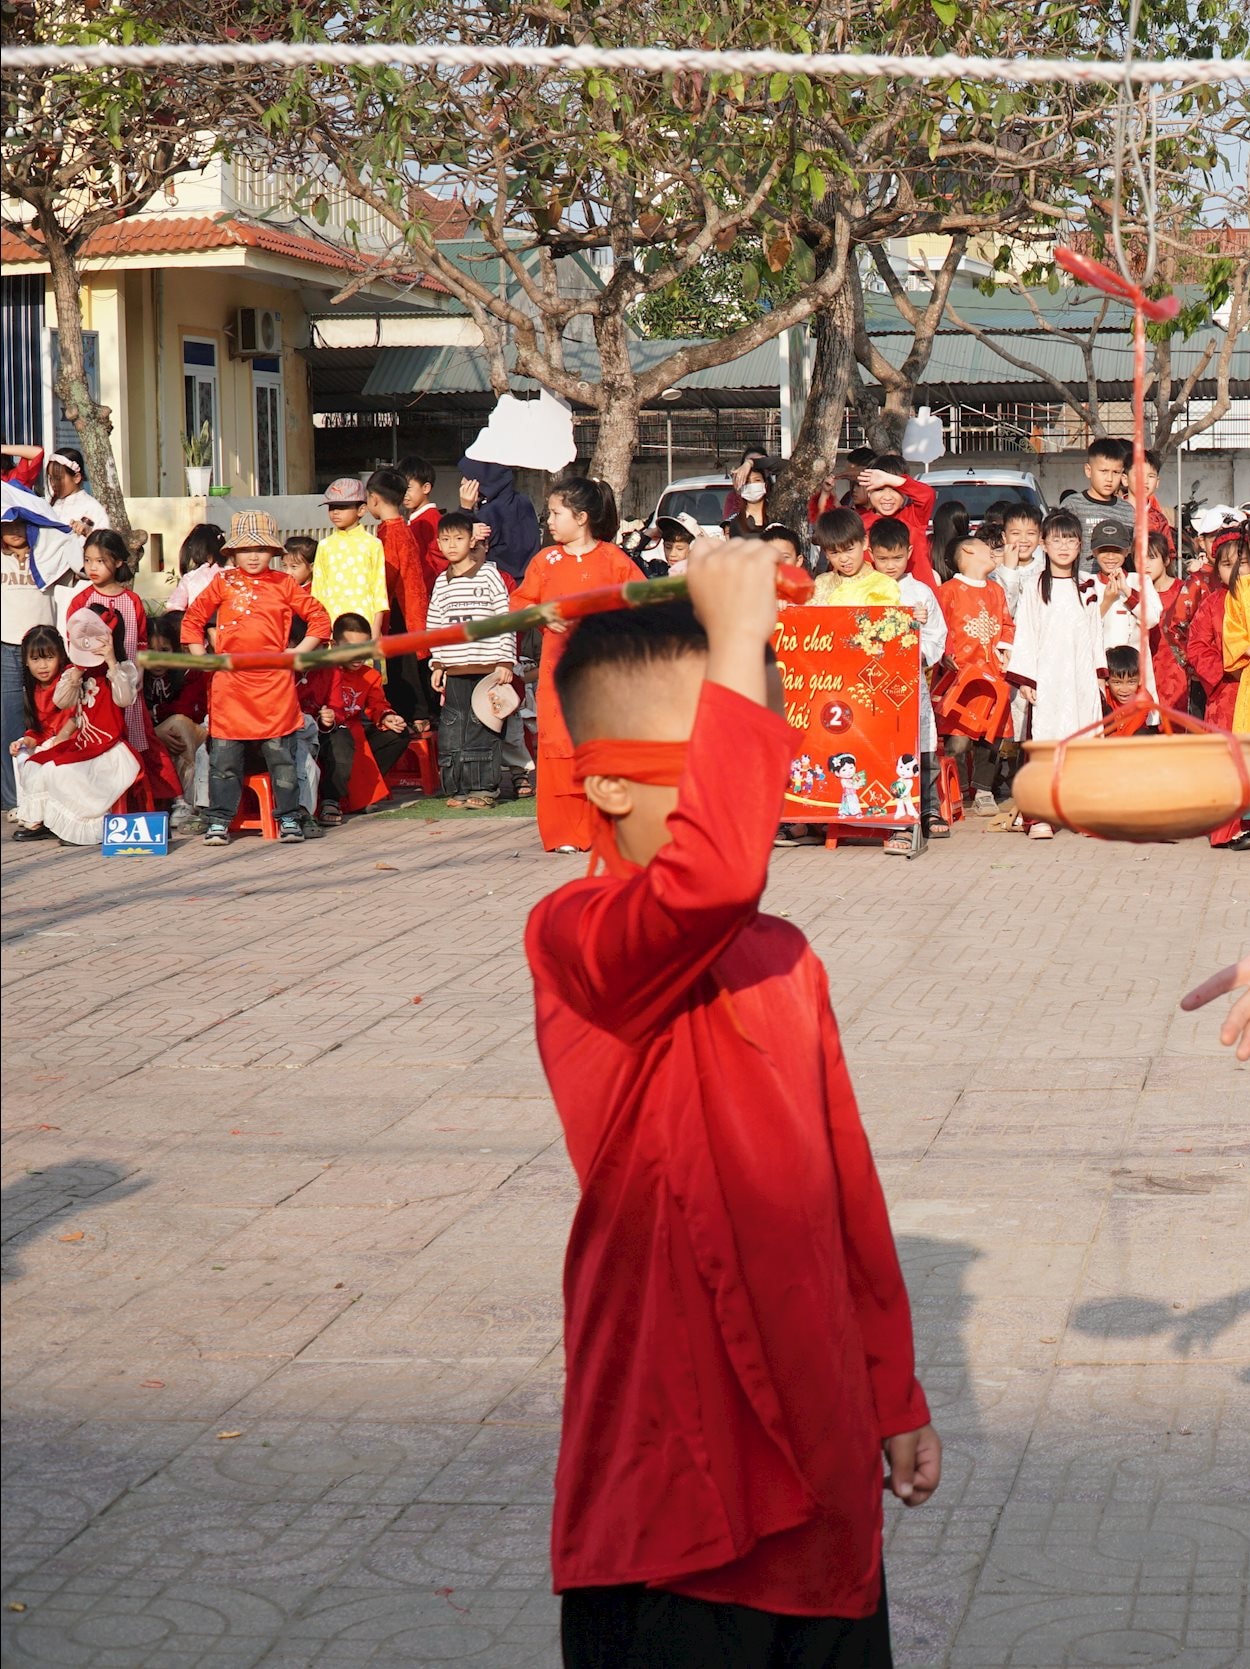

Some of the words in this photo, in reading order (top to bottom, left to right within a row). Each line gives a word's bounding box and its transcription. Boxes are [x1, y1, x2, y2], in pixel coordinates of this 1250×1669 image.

[803, 624, 834, 652] chơi
[809, 669, 843, 700] gian
[784, 702, 811, 729] hối
[829, 706, 843, 726] 2
